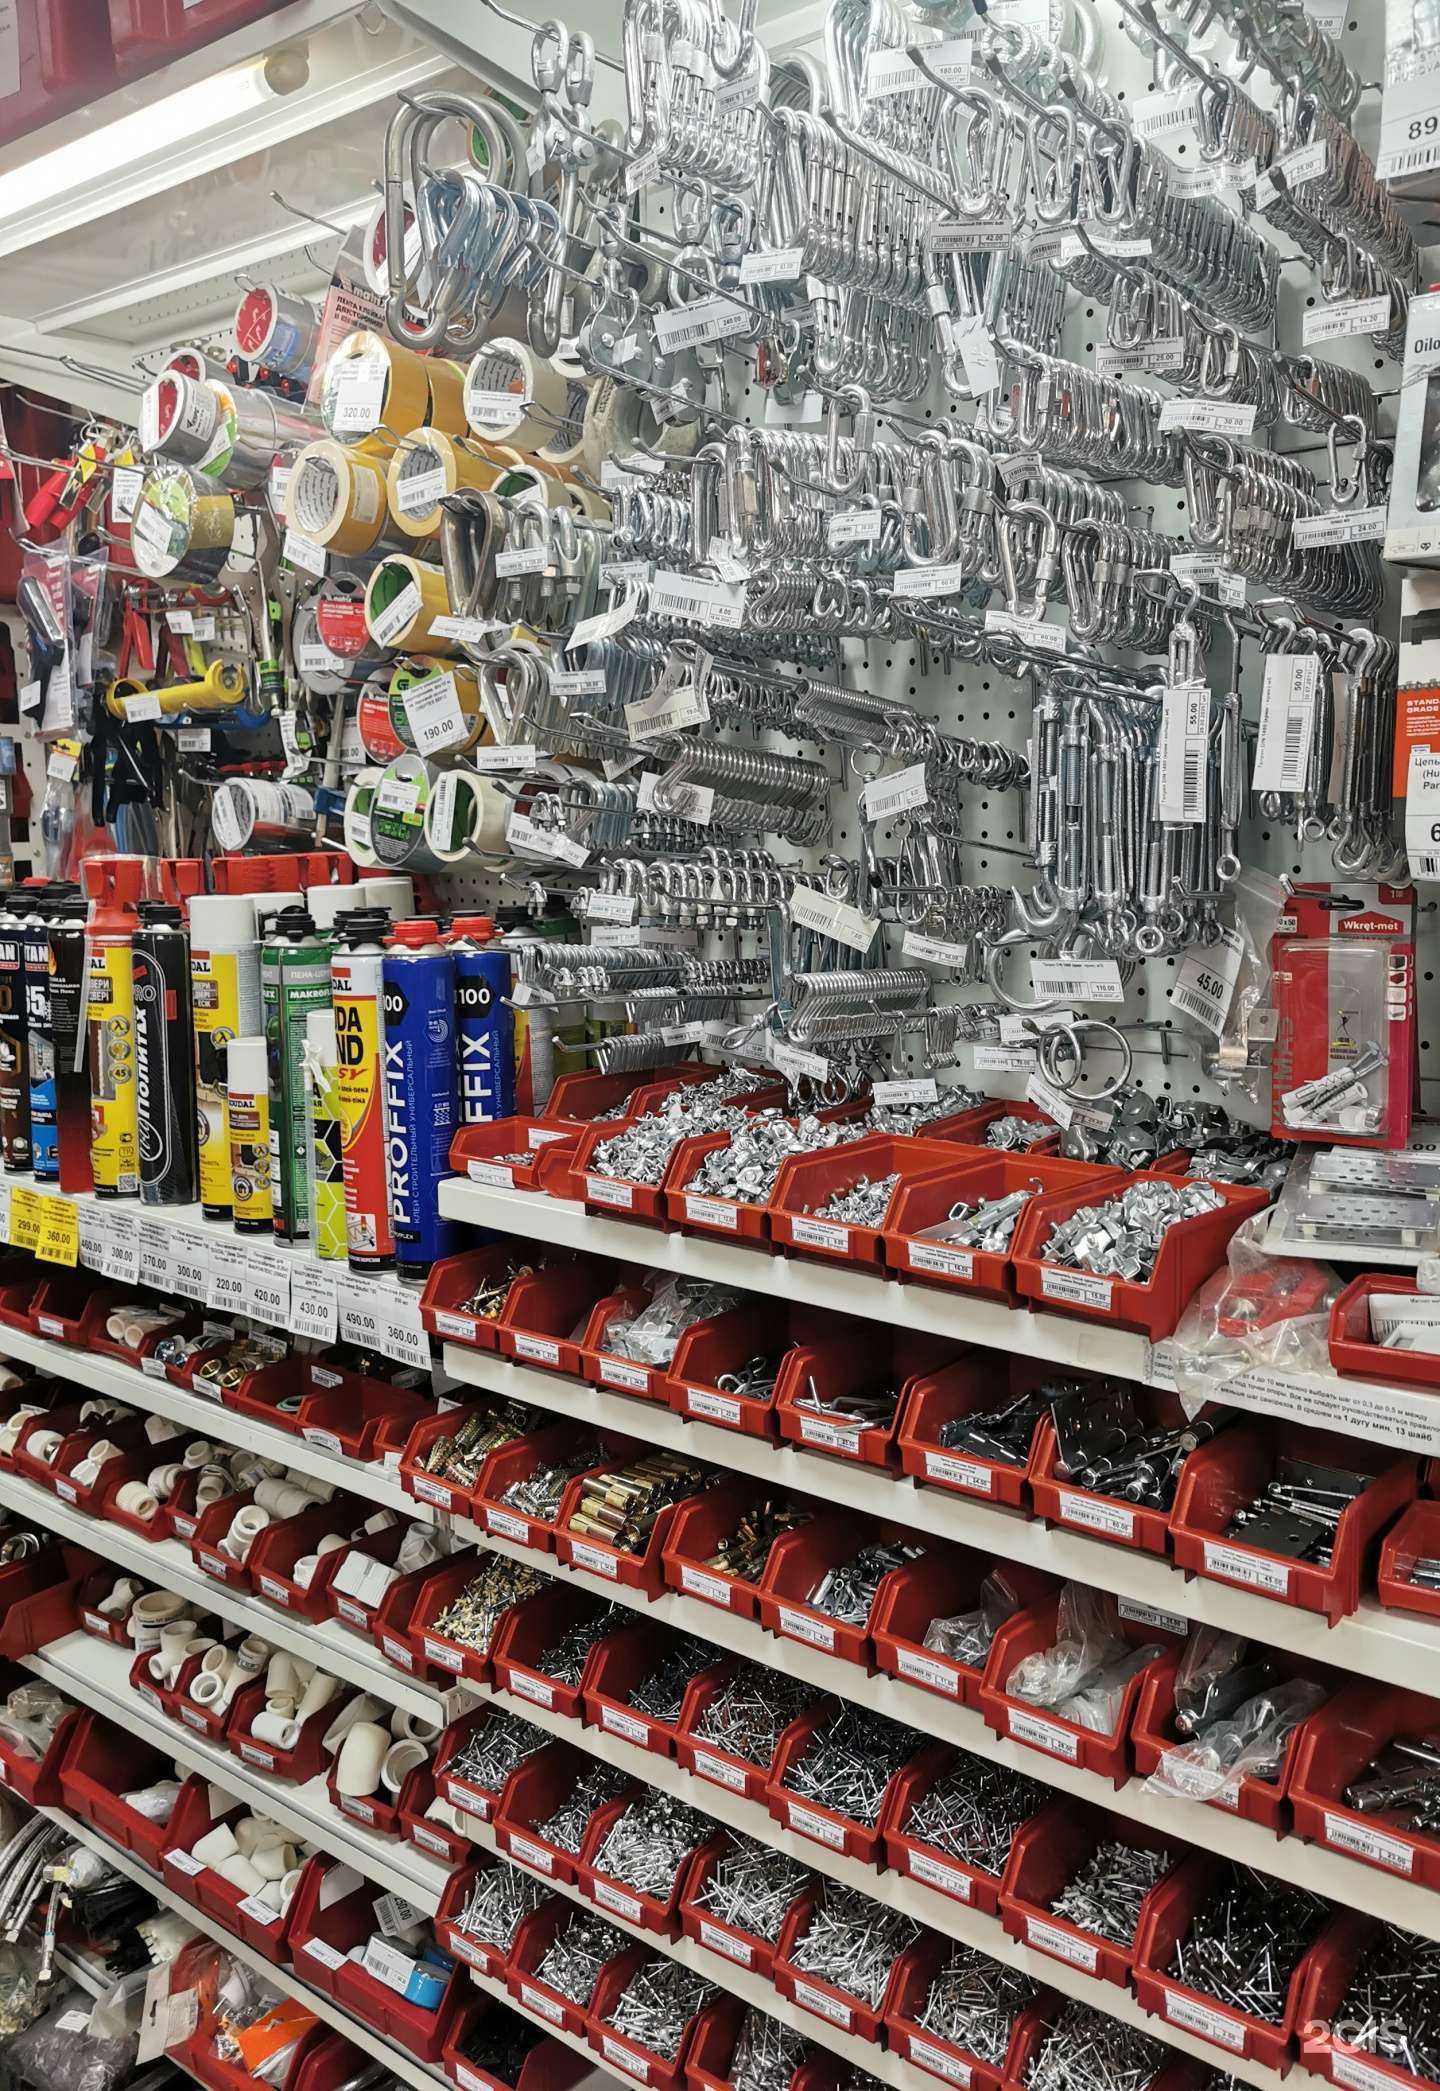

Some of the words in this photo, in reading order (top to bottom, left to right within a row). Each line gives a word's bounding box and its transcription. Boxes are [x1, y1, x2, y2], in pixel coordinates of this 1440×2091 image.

[1408, 117, 1439, 140] 89
[424, 719, 454, 740] 190.00
[1343, 920, 1399, 931] Wkręt-met
[332, 978, 351, 991] DAL
[1197, 972, 1224, 999] 45.00
[383, 995, 402, 1012] 00
[459, 988, 491, 1005] 100
[336, 1006, 363, 1033] DA
[336, 1033, 364, 1065] ND
[404, 1040, 416, 1122] УНИВЕРСАЛЬНЫЙ
[462, 1031, 493, 1122] FFIX
[385, 1040, 411, 1224] PROFFIX
[409, 1123, 419, 1198] СТРОИТЕЛЬНЫЙ
[17, 1219, 40, 1234] 299.00
[142, 1253, 167, 1270] 370.00
[176, 1264, 202, 1281] 300.00
[215, 1277, 242, 1293] 220.00
[253, 1288, 280, 1305] 420.00
[299, 1301, 328, 1319] 430.00
[345, 1312, 375, 1330] 490.00
[387, 1325, 418, 1346] 360.00
[1350, 1418, 1370, 1428] дугу
[1372, 1422, 1392, 1433] мин.
[1395, 1426, 1405, 1435] 13
[1407, 1430, 1433, 1442] шайб
